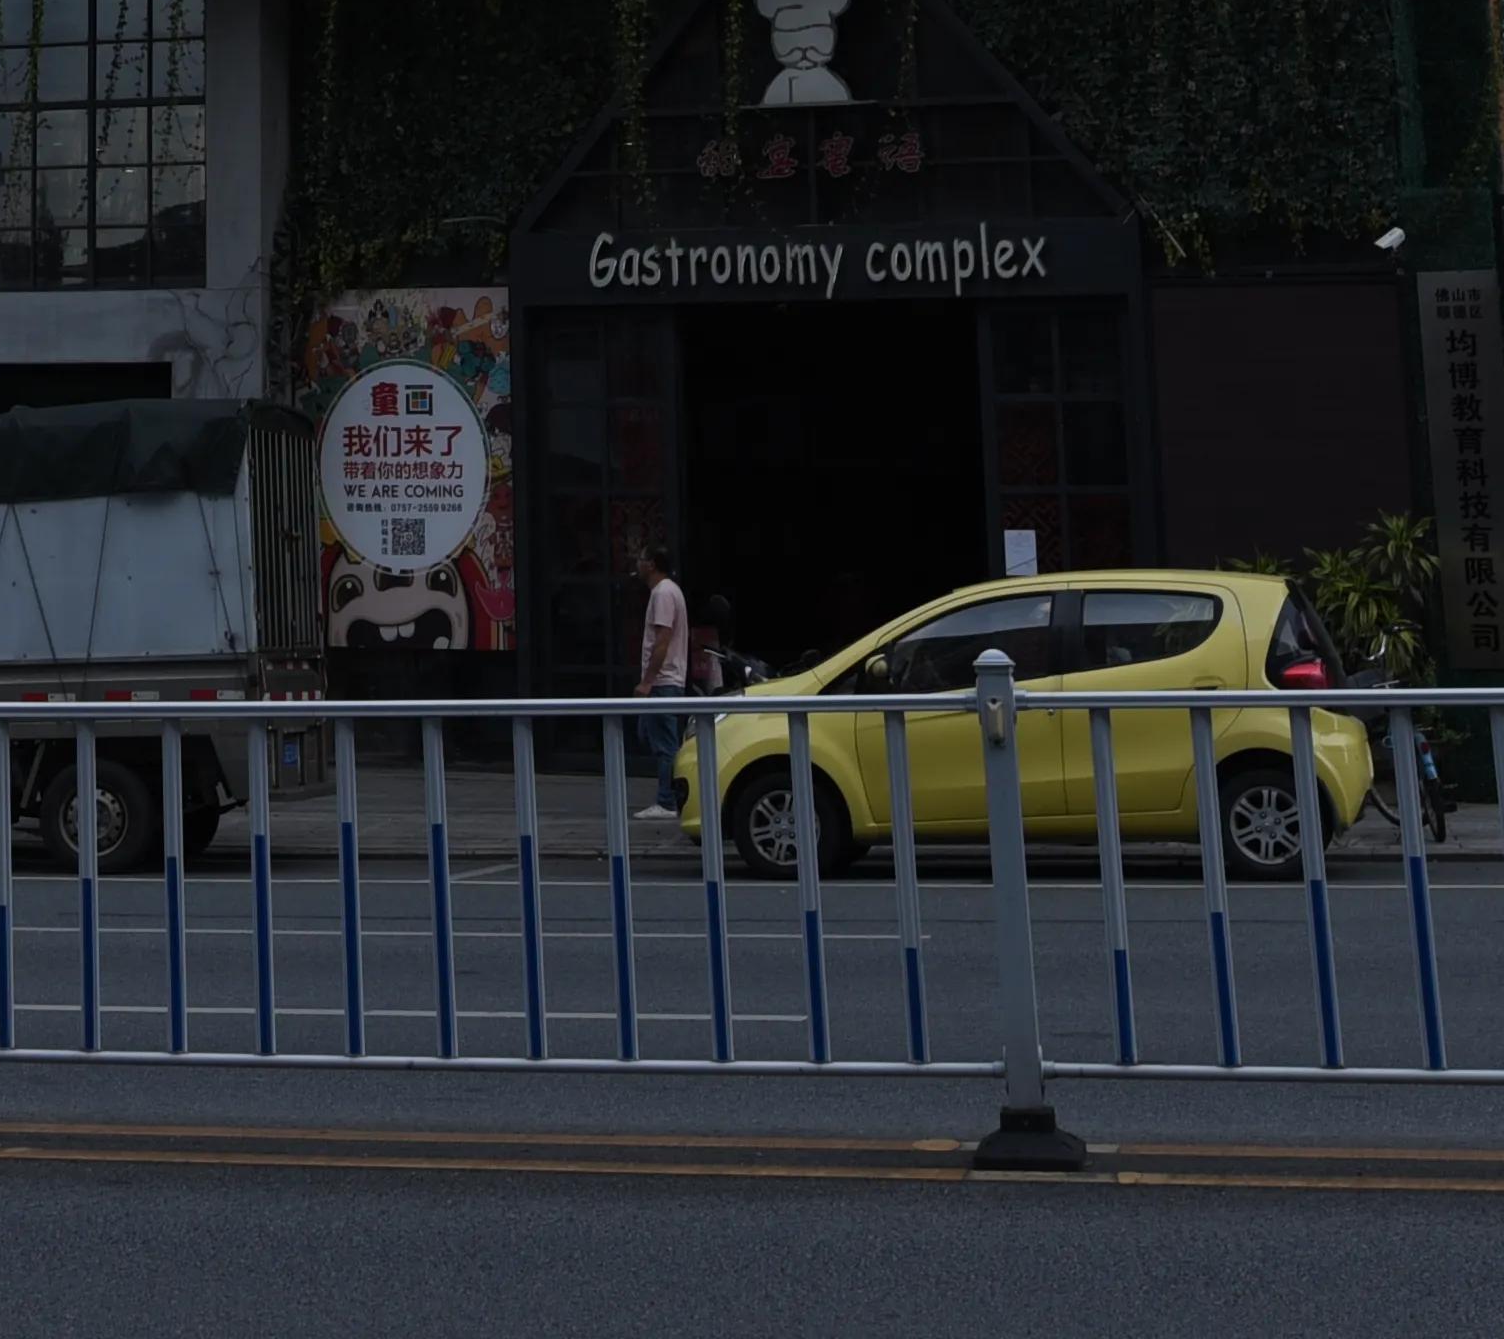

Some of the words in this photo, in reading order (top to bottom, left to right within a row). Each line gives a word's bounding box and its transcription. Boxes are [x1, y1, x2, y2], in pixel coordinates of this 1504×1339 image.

[589, 231, 844, 299] Gastronomy
[865, 222, 1047, 297] complex
[343, 425, 462, 458] 我们来了
[343, 461, 463, 481] 带着你的想象力
[344, 485, 366, 498] WE
[371, 485, 399, 498] ARE
[405, 485, 464, 498] COMING
[1446, 329, 1500, 652] 均博教育科技有限公司
